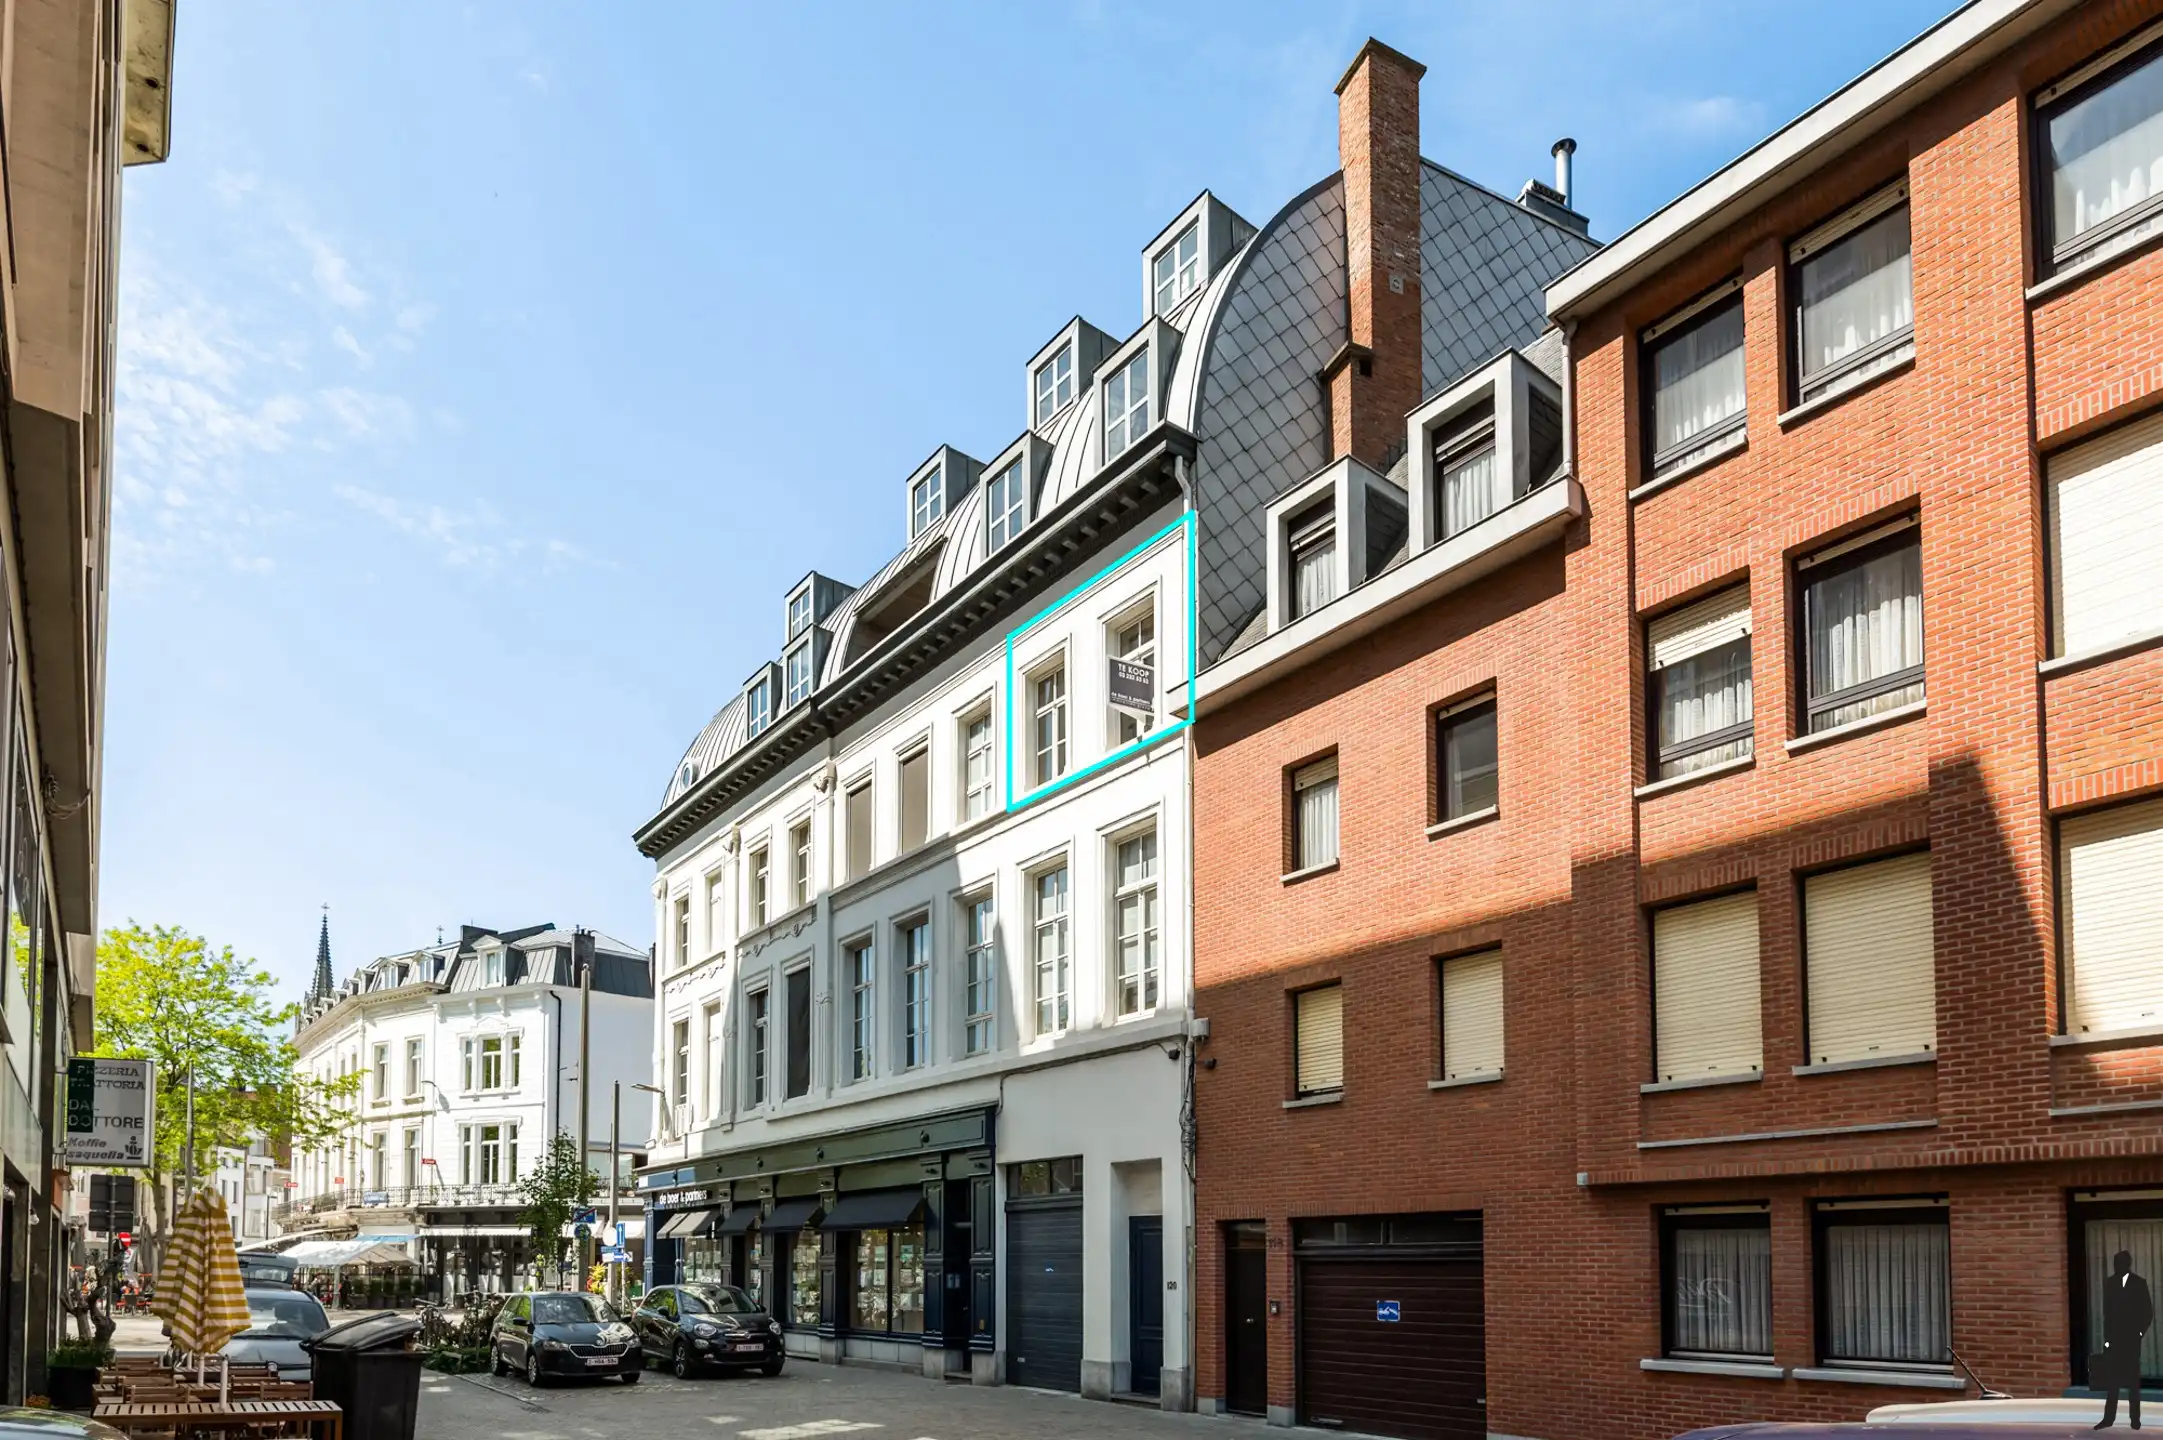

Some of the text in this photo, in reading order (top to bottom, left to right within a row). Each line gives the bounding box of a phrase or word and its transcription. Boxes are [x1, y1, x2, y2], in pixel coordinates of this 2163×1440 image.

[1118, 664, 1149, 677] TE KOOP
[69, 1114, 144, 1129] DOTTORE
[660, 1193, 666, 1204] de
[667, 1192, 679, 1204] boer
[685, 1189, 707, 1204] partners
